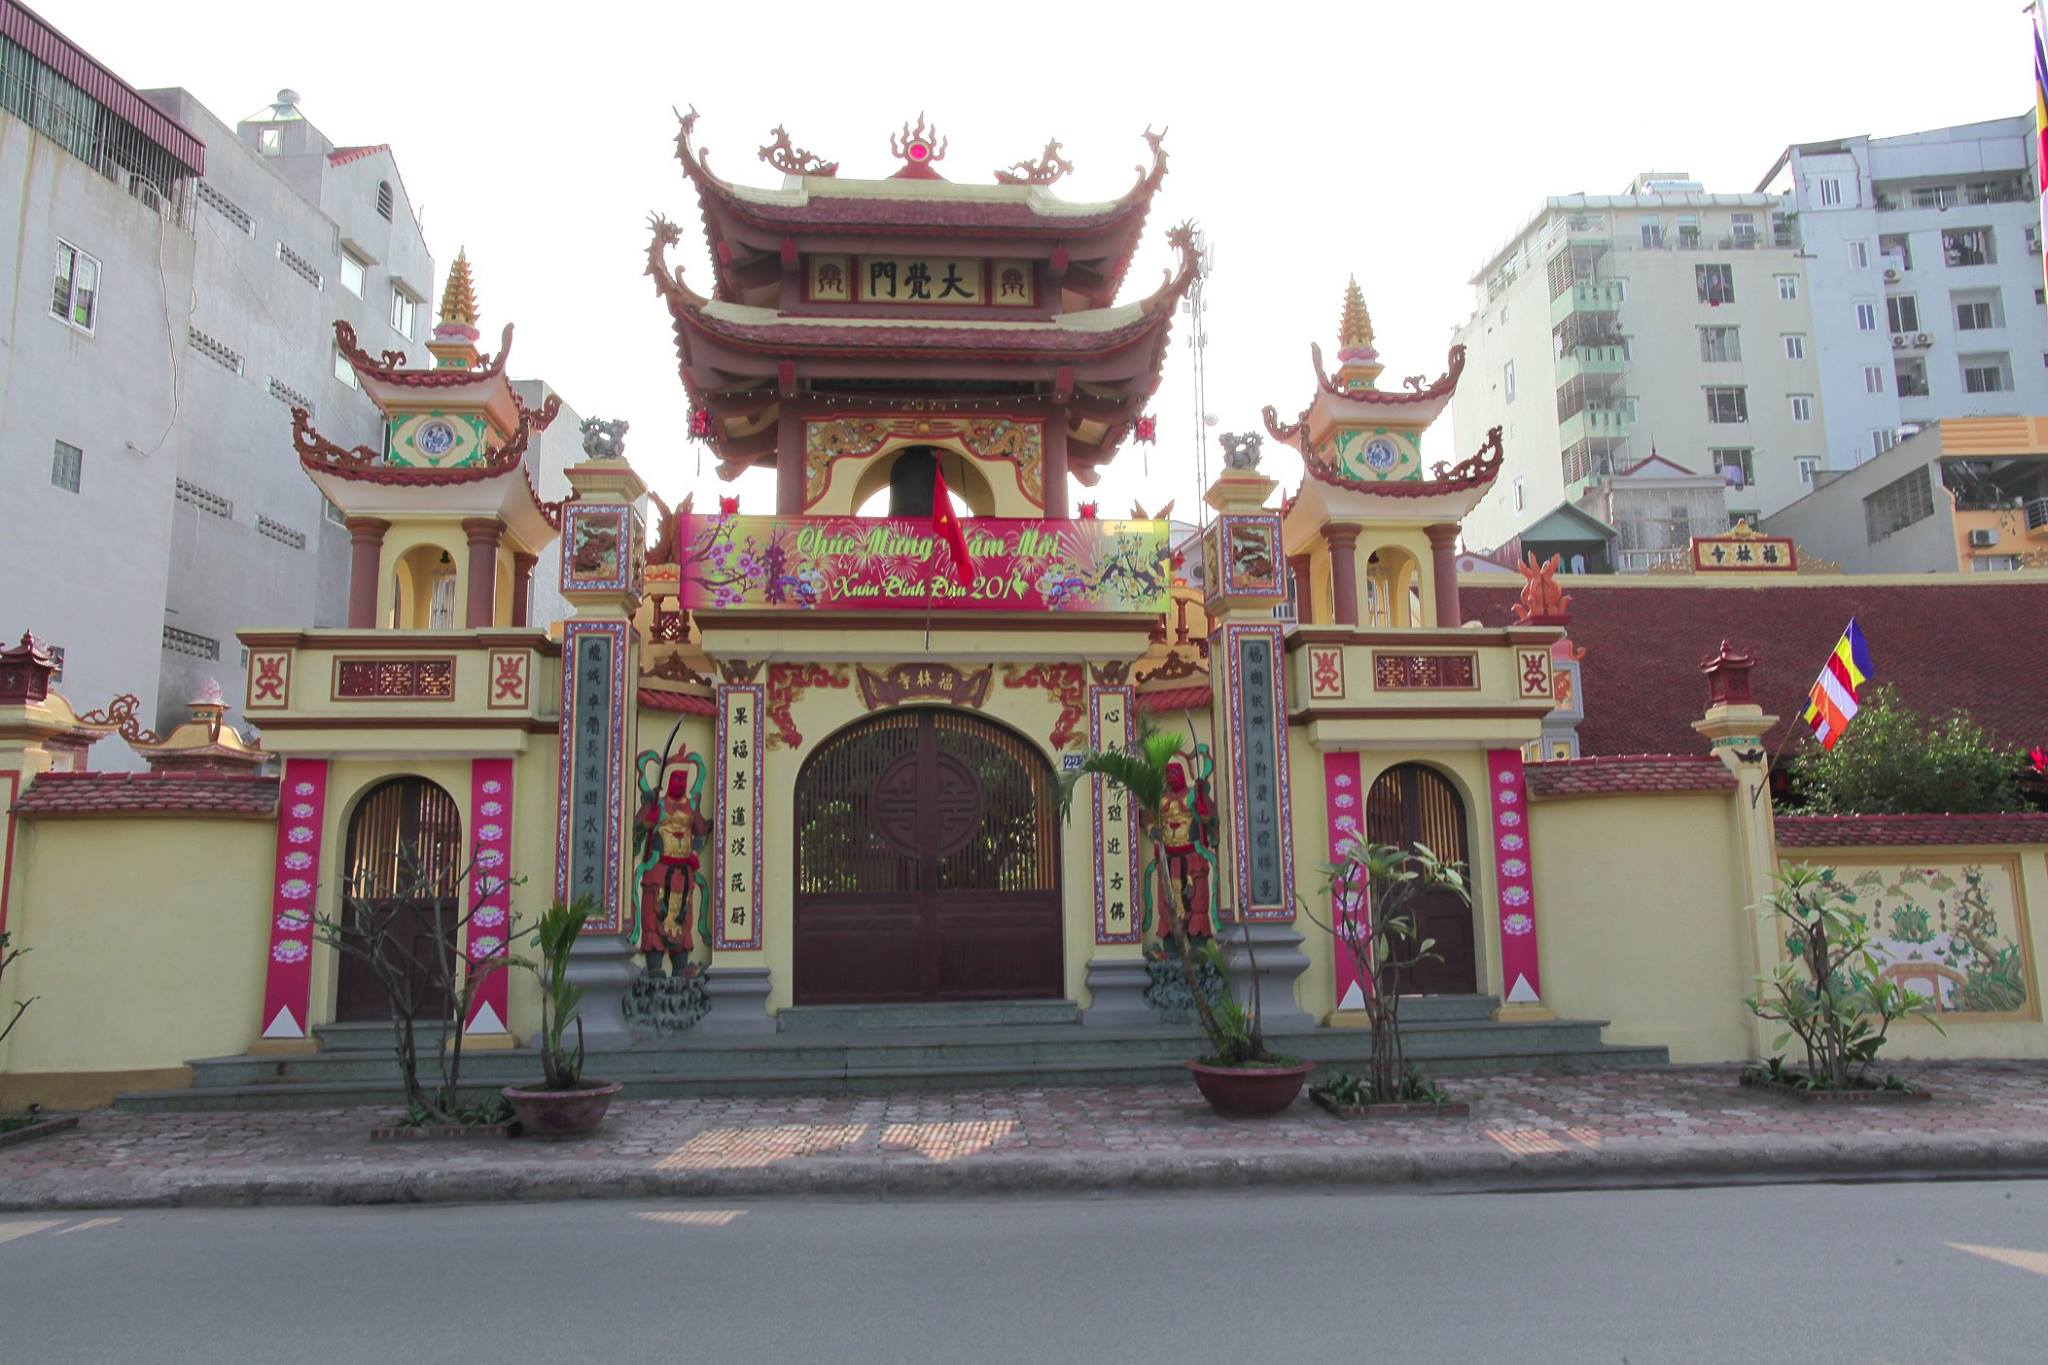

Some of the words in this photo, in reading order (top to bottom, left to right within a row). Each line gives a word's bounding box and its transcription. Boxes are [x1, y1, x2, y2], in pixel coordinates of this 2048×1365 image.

[796, 525, 857, 556] Chúc
[865, 526, 935, 562] Mừng
[1010, 528, 1061, 557] Mới
[832, 573, 880, 600] Xuân
